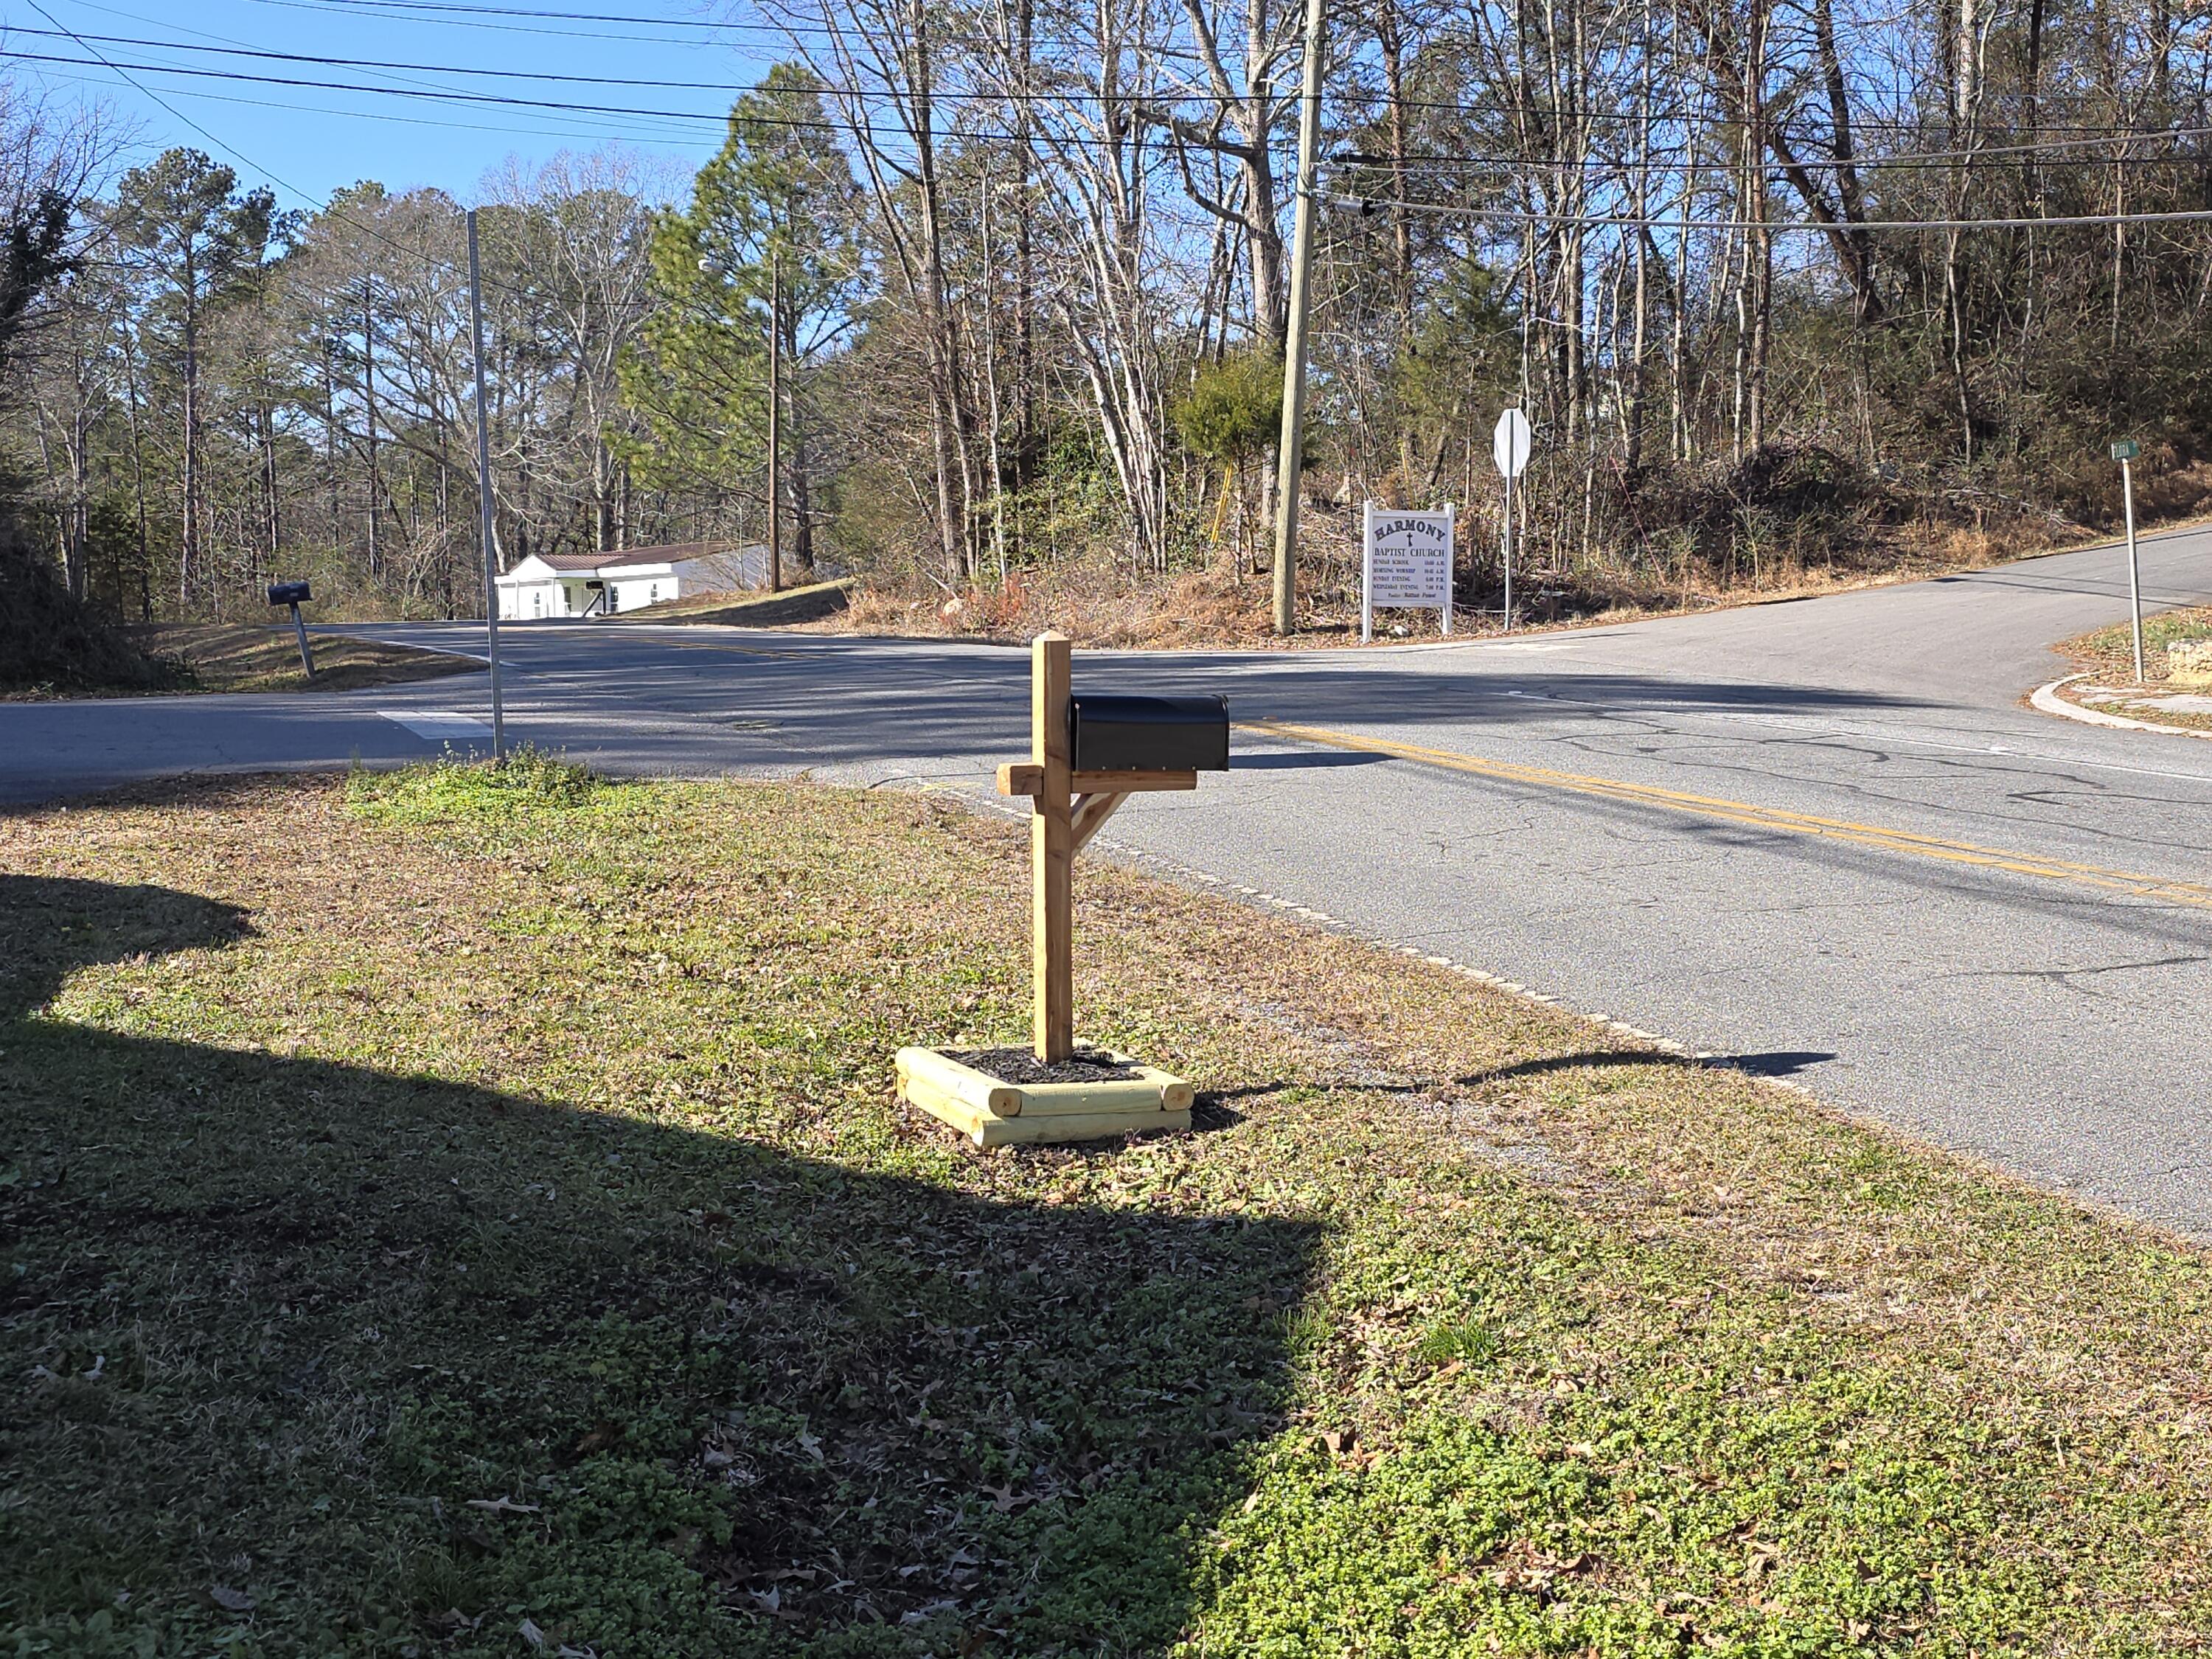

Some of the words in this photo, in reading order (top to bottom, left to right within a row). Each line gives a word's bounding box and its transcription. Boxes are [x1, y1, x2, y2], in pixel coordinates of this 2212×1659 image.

[1374, 520, 1445, 541] HARMONY
[1374, 548, 1405, 556] BAPTIST
[1411, 549, 1444, 557] CHURCH
